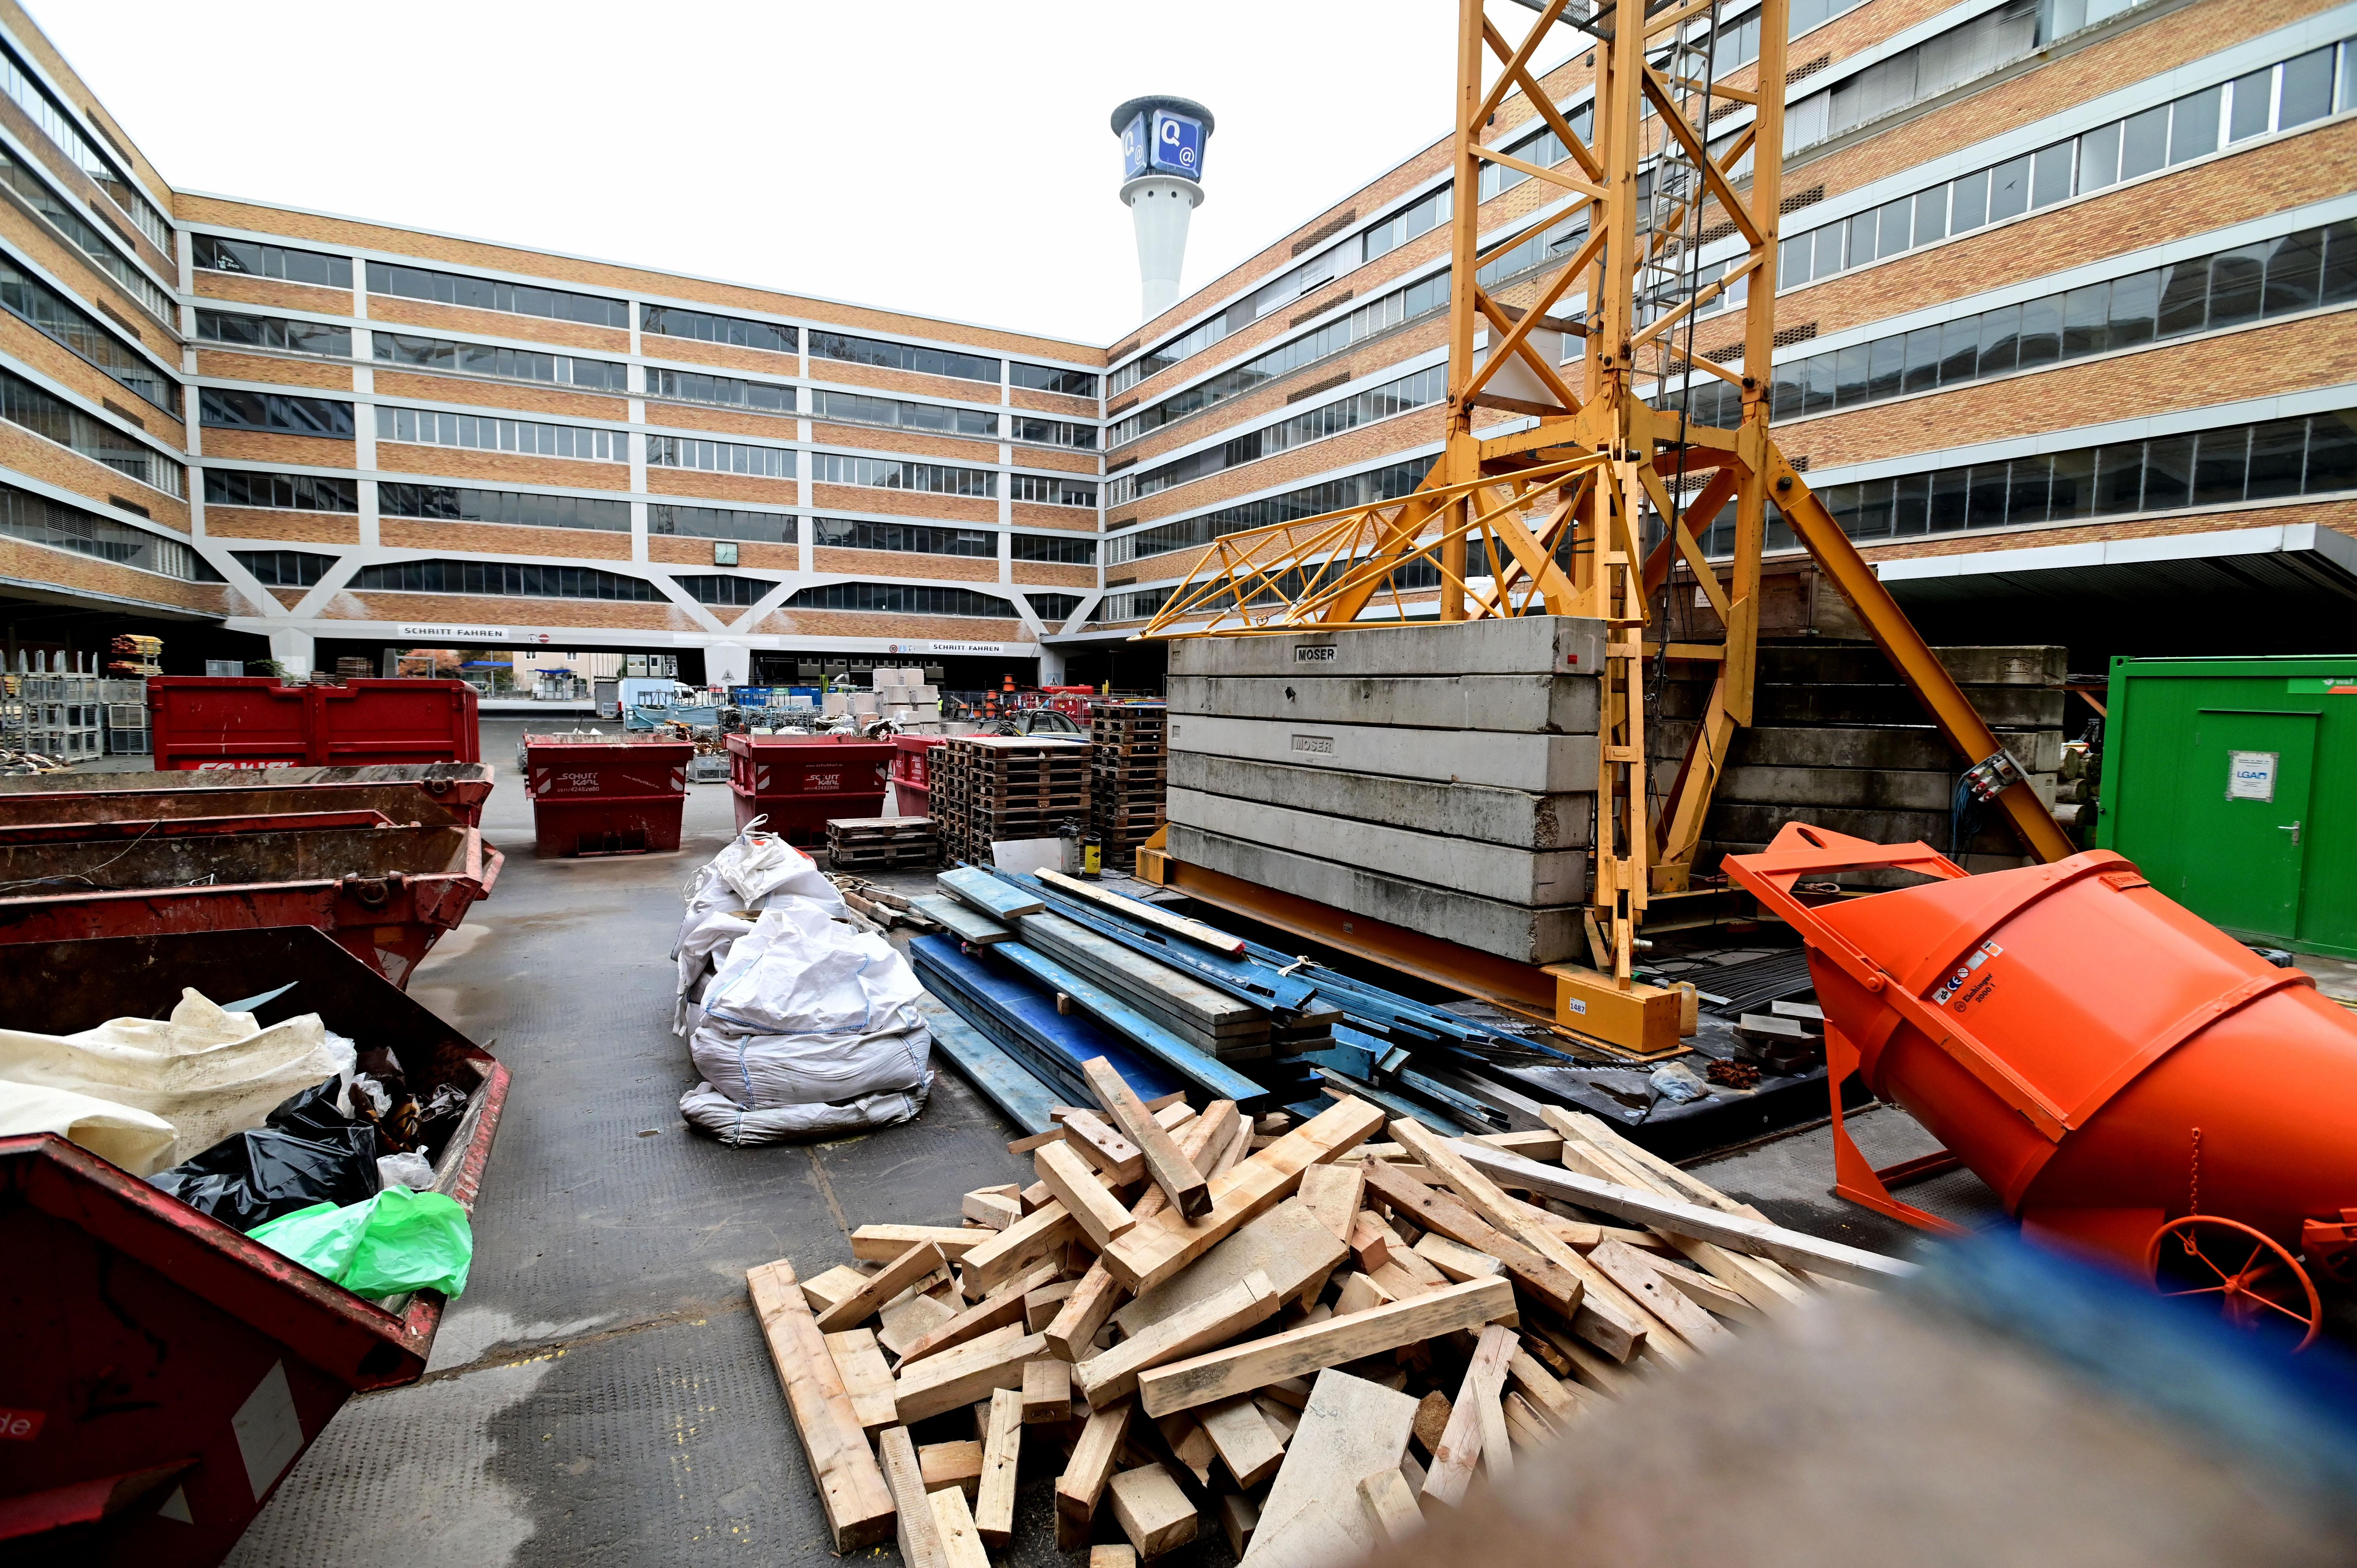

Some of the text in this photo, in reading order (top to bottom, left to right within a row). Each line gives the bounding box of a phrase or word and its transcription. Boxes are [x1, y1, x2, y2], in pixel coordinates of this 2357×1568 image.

[1161, 120, 1180, 147] Q
[1179, 147, 1194, 166] @
[1298, 648, 1334, 660] MOSER
[1296, 738, 1331, 753] MOSER
[1947, 976, 1963, 991] CE
[1962, 973, 1993, 1003] Eichinger
[1941, 990, 1948, 1000] GS
[1975, 987, 1992, 1003] 2000
[1570, 1003, 1585, 1013] 1487
